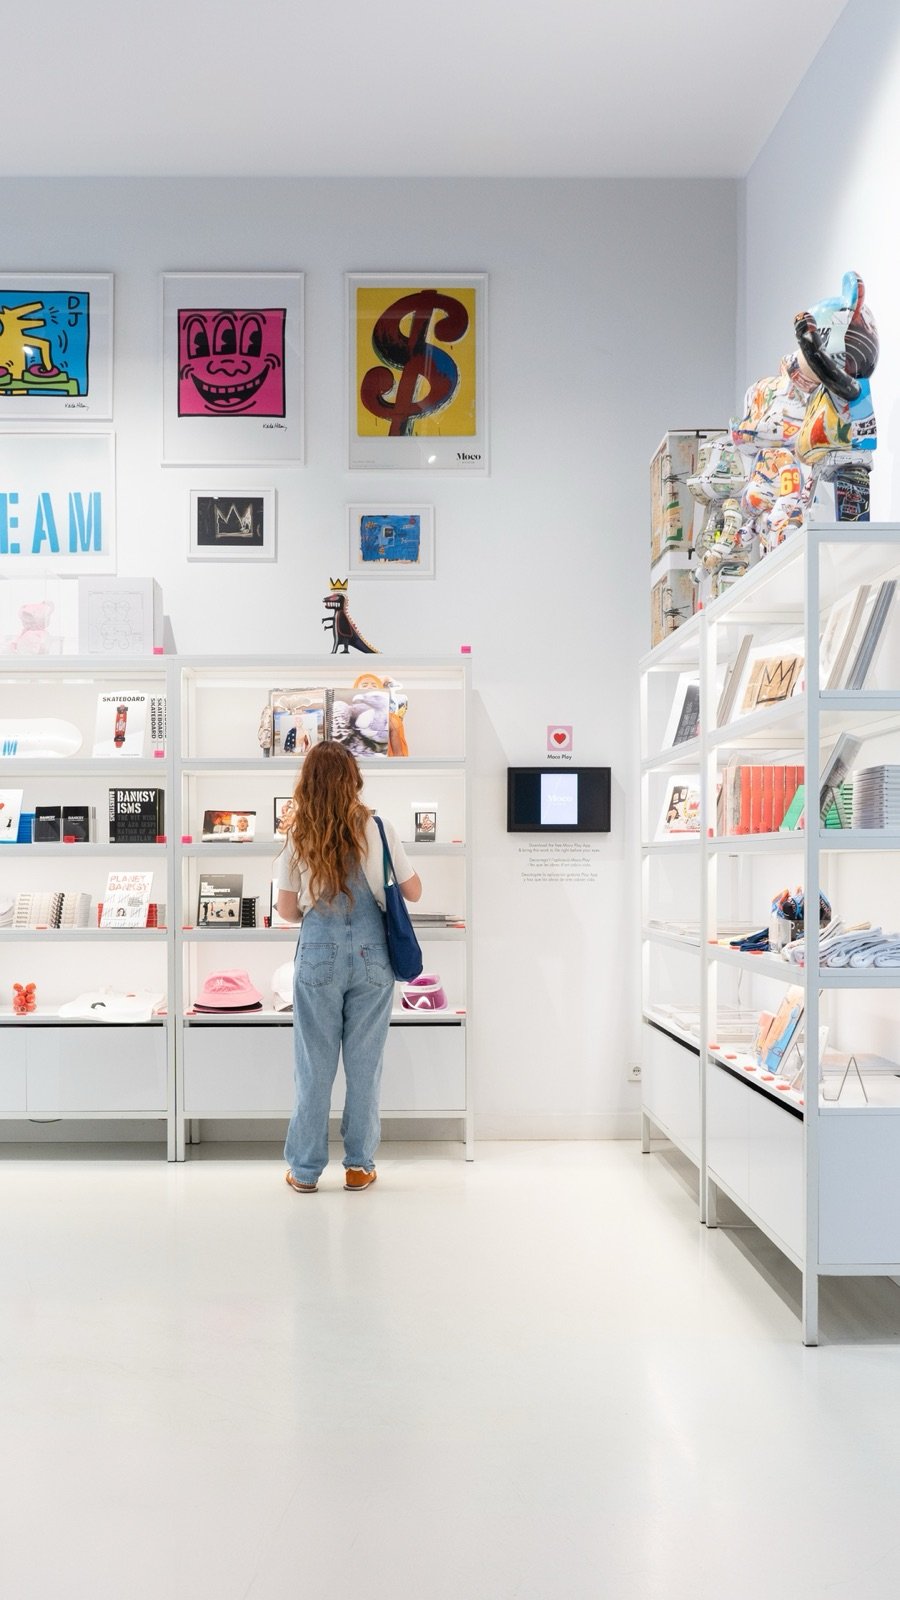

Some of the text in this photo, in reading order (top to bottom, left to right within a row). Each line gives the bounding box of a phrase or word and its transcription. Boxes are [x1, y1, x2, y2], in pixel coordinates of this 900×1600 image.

[456, 452, 482, 461] Moco
[780, 471, 800, 496] 69
[117, 790, 156, 803] BANKSY
[117, 802, 142, 814] ISMS
[110, 875, 147, 883] PLANET
[108, 882, 150, 892] BANKSY
